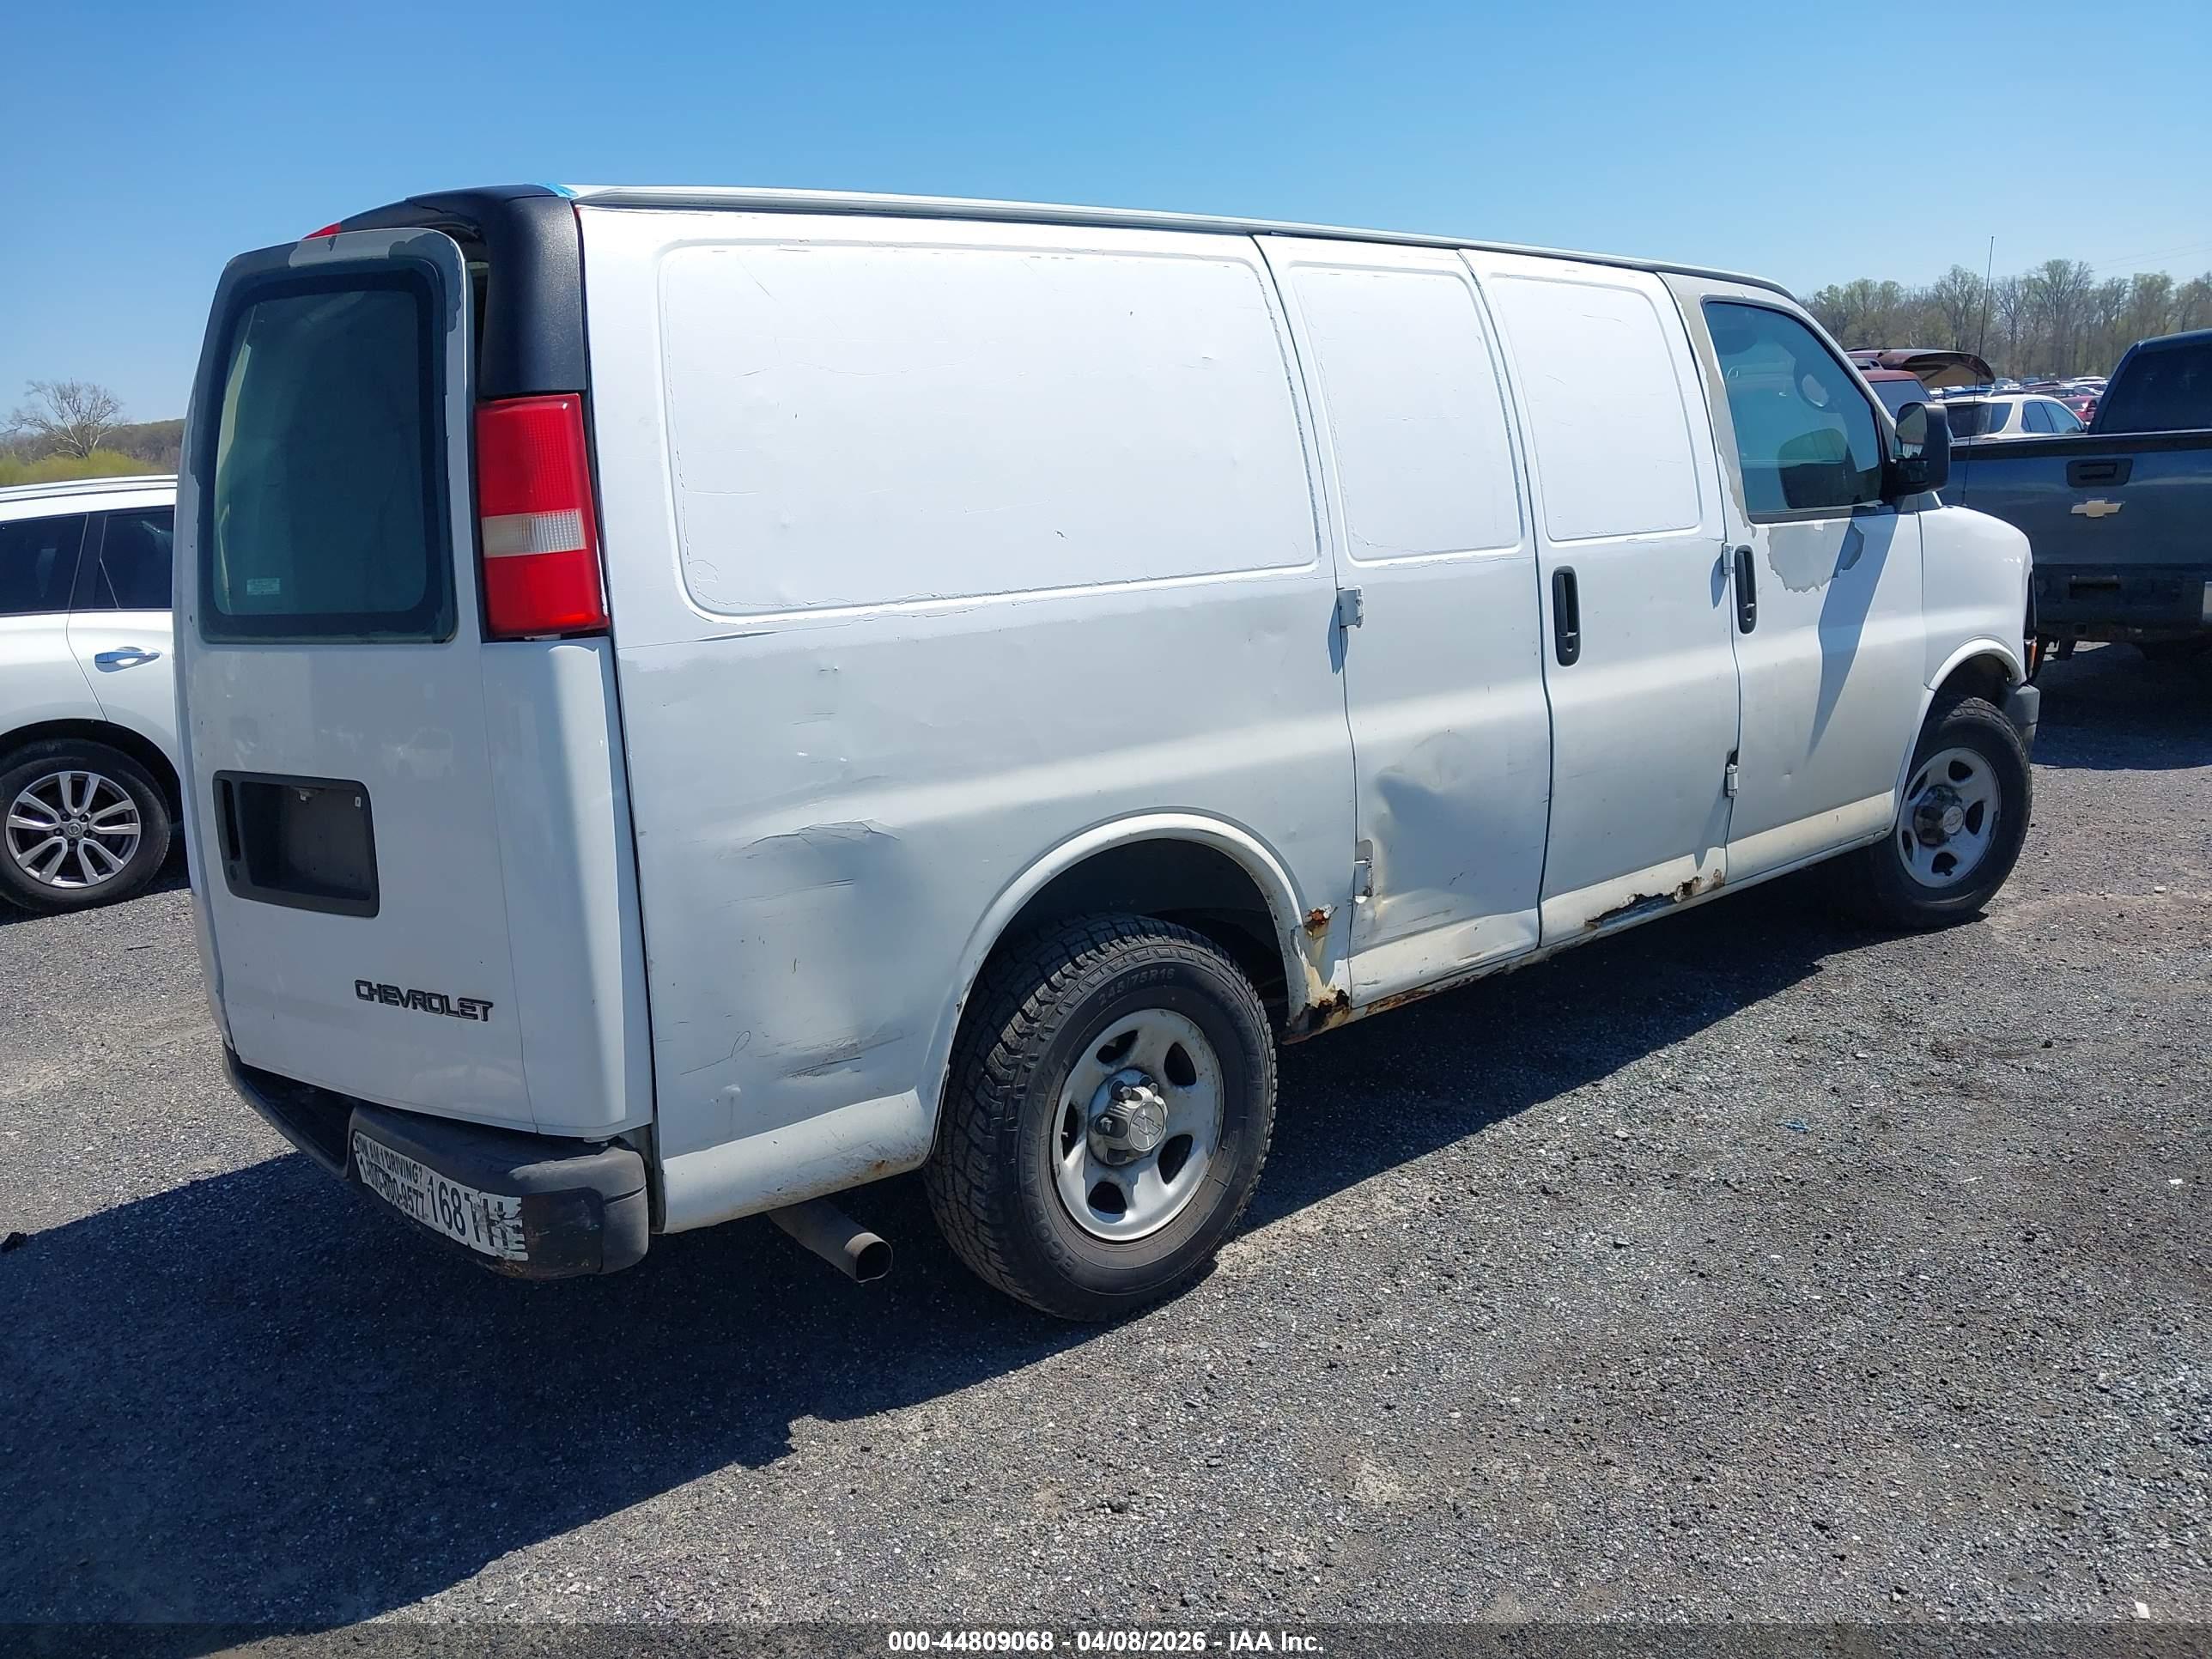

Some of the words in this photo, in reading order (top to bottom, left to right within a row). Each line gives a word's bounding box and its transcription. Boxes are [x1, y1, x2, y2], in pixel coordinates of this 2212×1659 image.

[354, 979, 494, 1023] CHEVROLET
[1098, 968, 1176, 1007] 245/75R16
[384, 1151, 422, 1187] DRIVING?
